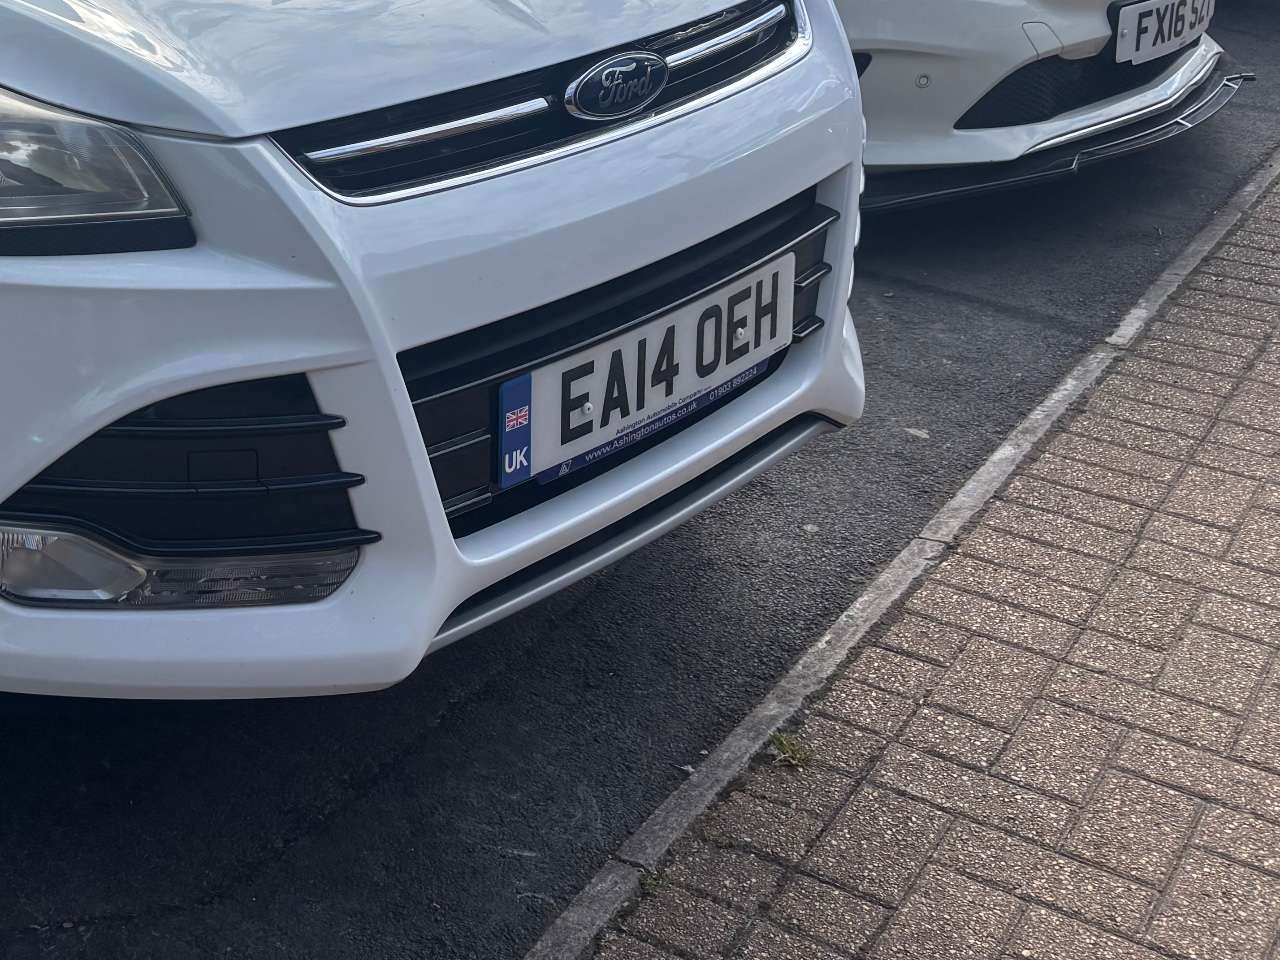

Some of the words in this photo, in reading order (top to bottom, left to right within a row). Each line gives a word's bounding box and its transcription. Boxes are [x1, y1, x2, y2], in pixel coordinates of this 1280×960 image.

[598, 60, 654, 107] Ford
[560, 325, 680, 446] EA14
[695, 271, 780, 379] OEH
[504, 446, 528, 474] UK
